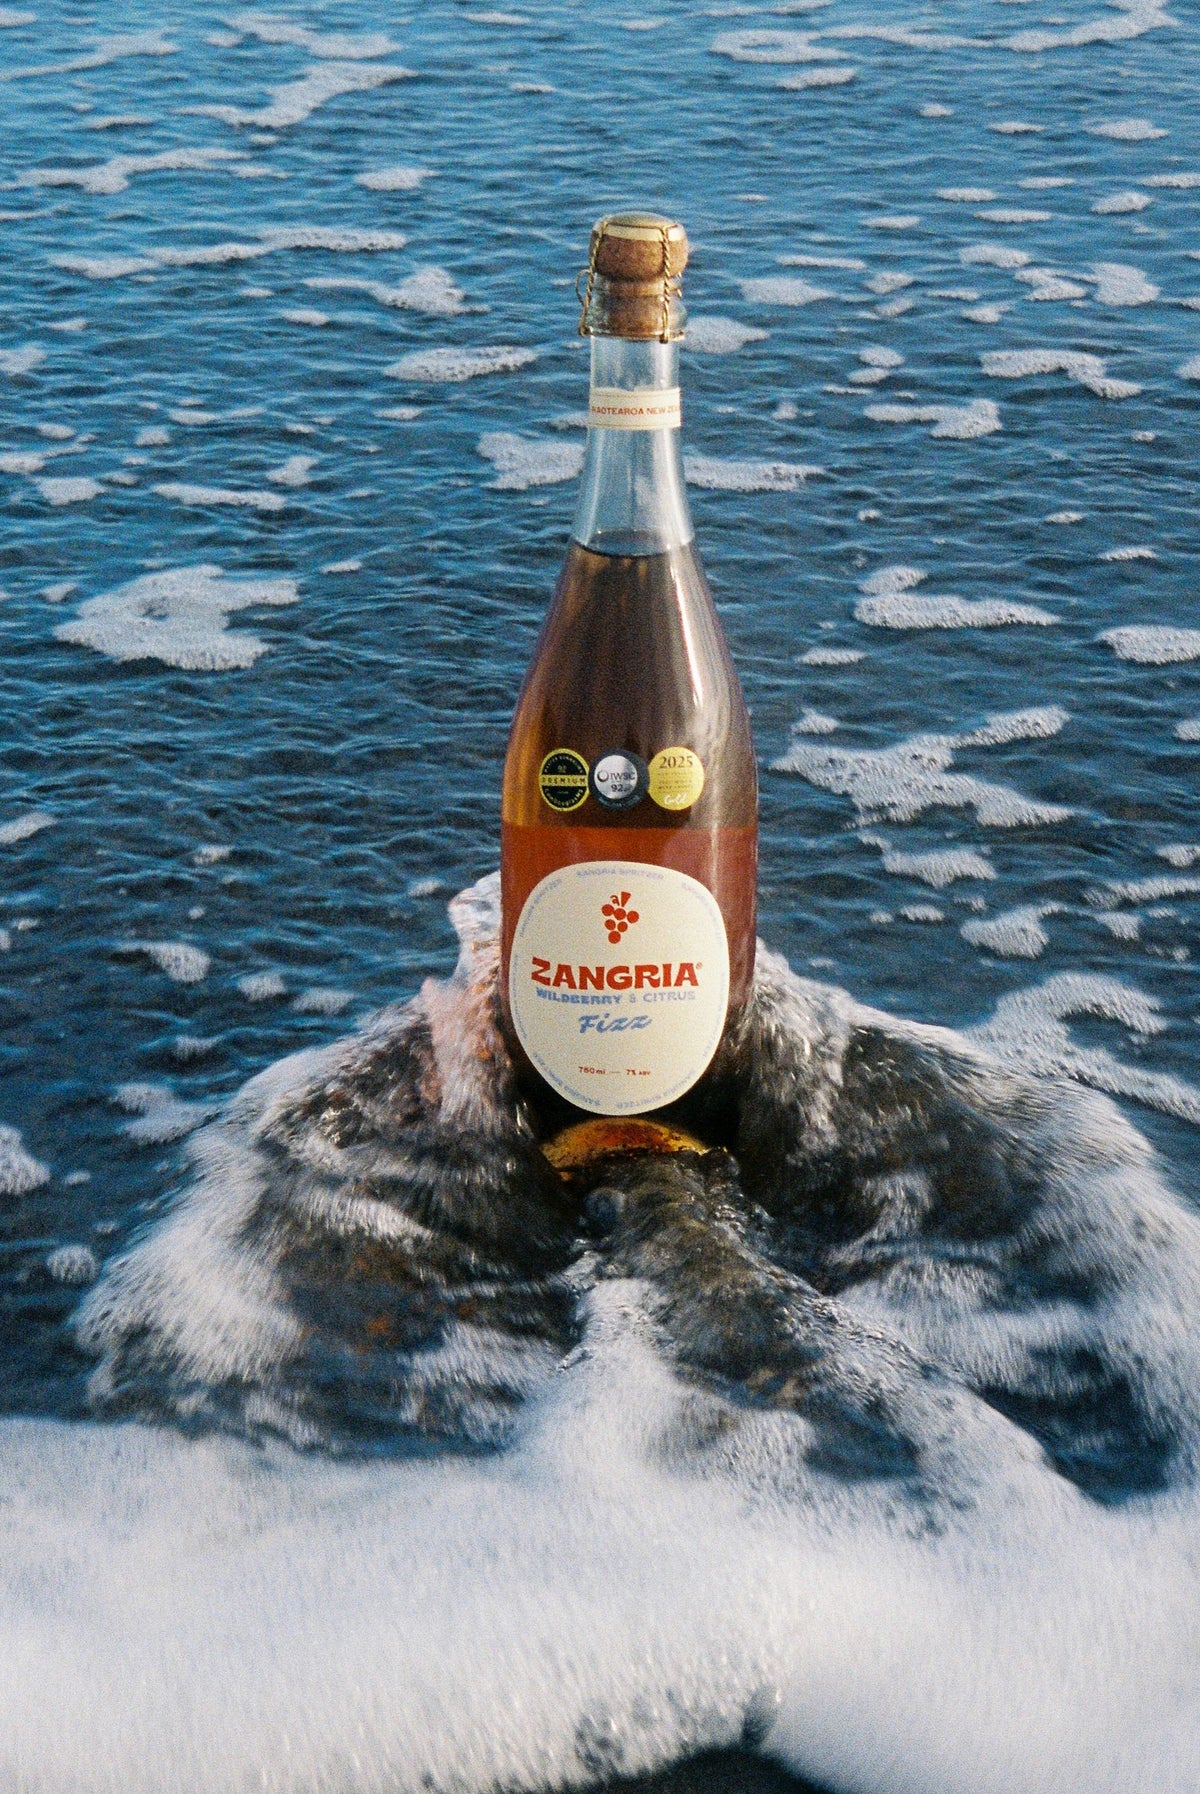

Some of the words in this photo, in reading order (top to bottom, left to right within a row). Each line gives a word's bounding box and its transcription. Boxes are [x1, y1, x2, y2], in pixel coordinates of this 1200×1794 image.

[597, 406, 644, 416] AOTEAROA
[646, 406, 666, 415] NEW
[660, 755, 693, 769] 2025
[541, 777, 586, 785] PREMIUM
[610, 772, 635, 781] IWSC
[610, 784, 624, 792] 92
[535, 986, 623, 1005] WILDBERRY
[629, 993, 636, 1003] &
[643, 990, 696, 1003] CITRUS
[578, 1012, 653, 1034] Fizz
[578, 1066, 606, 1076] 750ml
[625, 1068, 637, 1076] 7%
